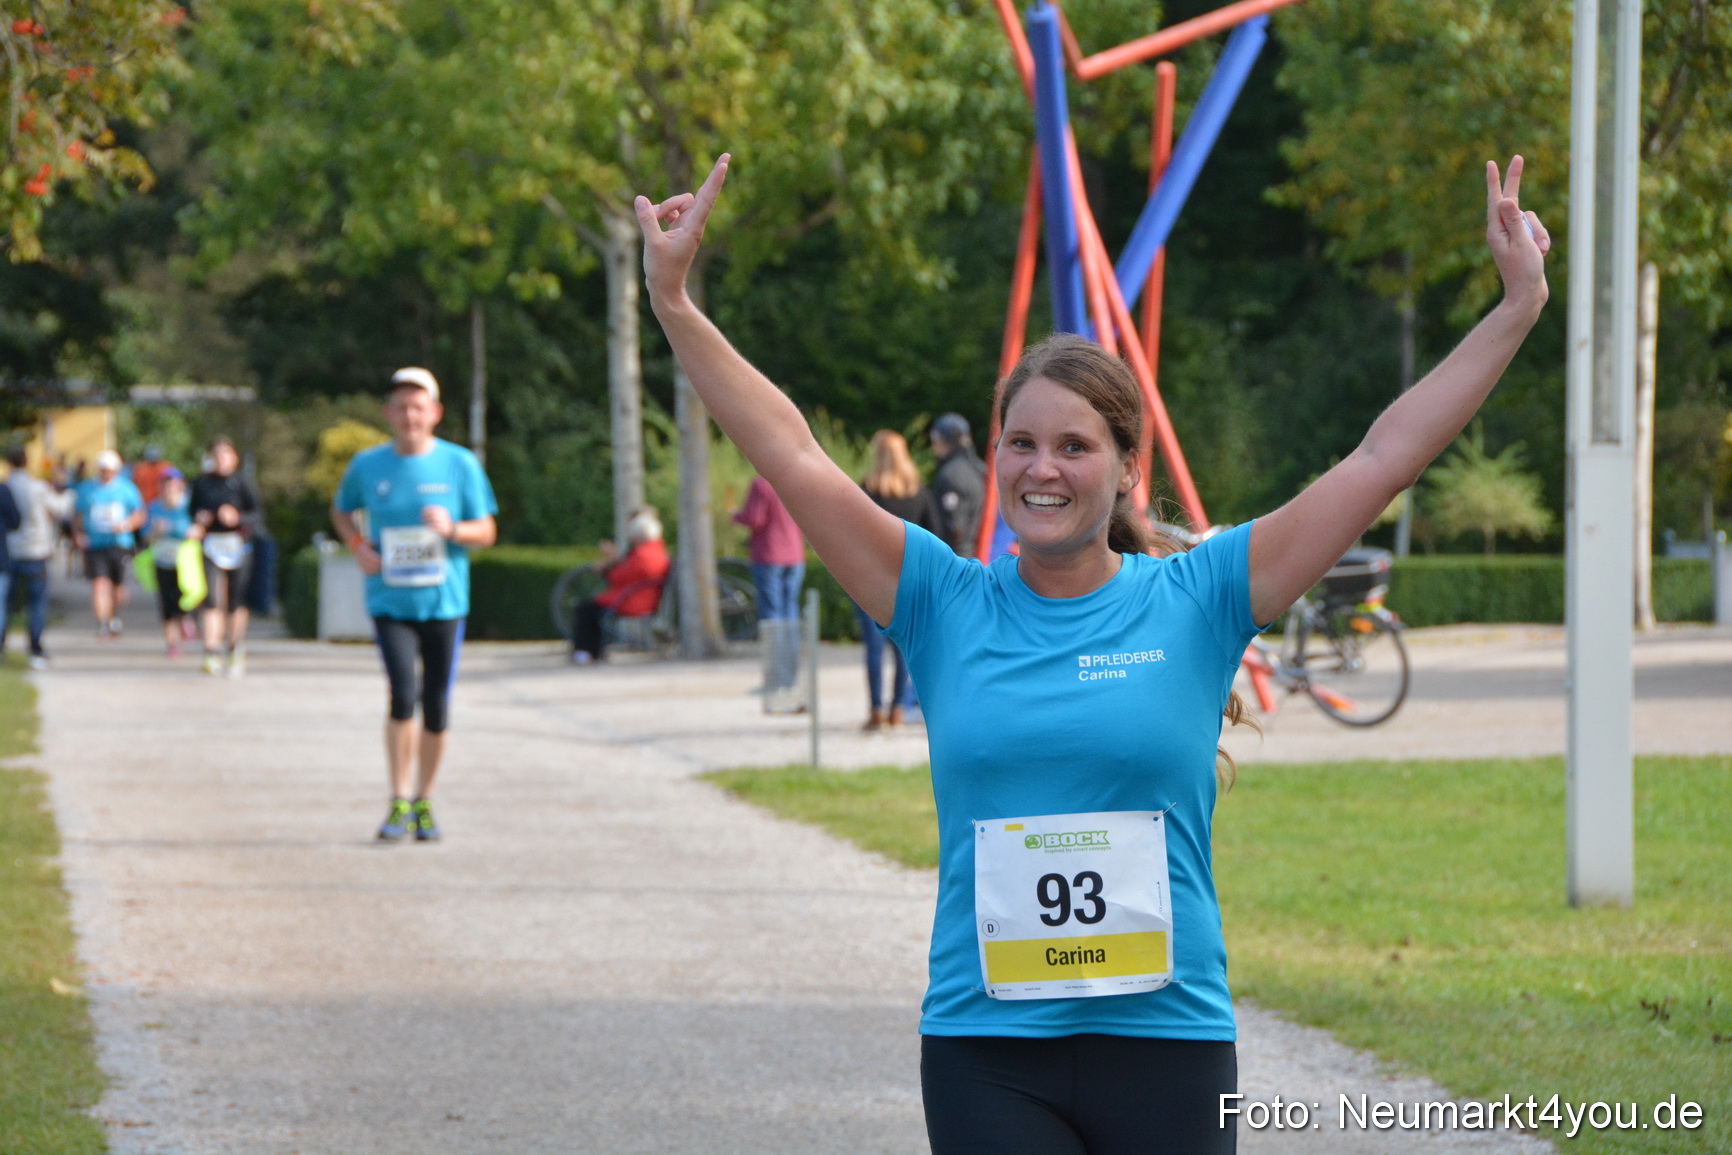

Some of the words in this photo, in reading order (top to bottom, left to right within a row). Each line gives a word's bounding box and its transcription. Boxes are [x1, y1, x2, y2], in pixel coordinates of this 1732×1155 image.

[1093, 649, 1166, 667] PFLEIDERER
[1078, 669, 1127, 682] Carina
[1044, 830, 1110, 848] BOCK
[1036, 870, 1107, 927] 93
[987, 924, 994, 933] D
[1045, 946, 1106, 966] Carina
